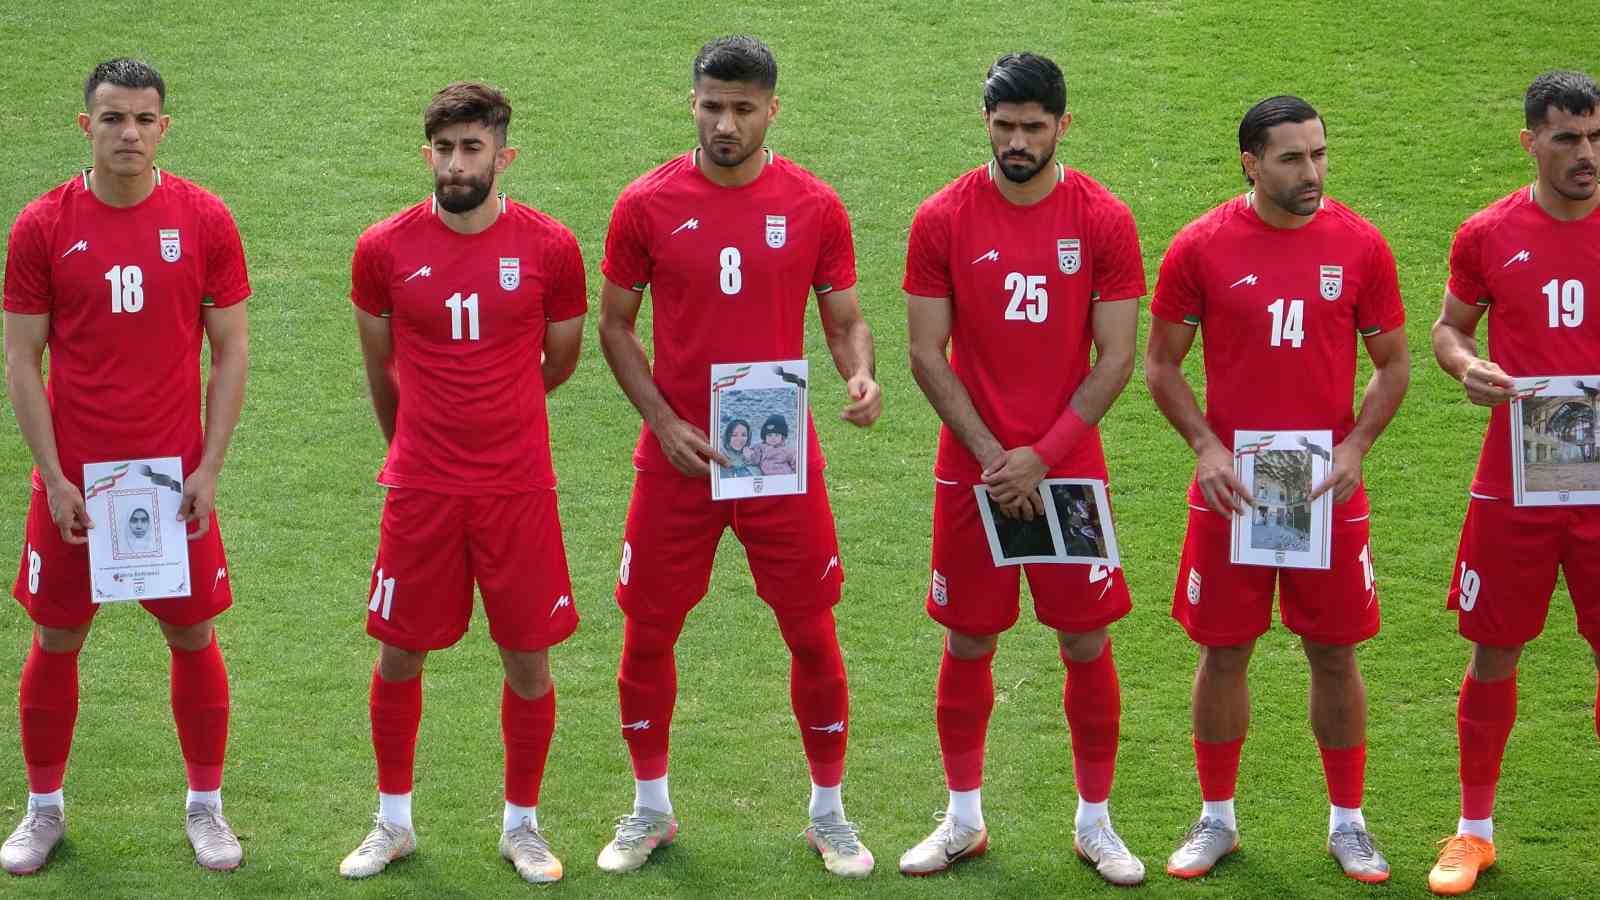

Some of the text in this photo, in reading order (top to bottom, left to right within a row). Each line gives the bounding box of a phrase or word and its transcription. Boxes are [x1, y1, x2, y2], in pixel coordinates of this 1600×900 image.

[105, 265, 144, 313] 18
[719, 247, 742, 295] 8
[445, 292, 480, 340] 11
[1004, 272, 1049, 323] 25
[1542, 279, 1584, 328] 19
[1267, 299, 1305, 348] 14
[620, 541, 632, 585] 8
